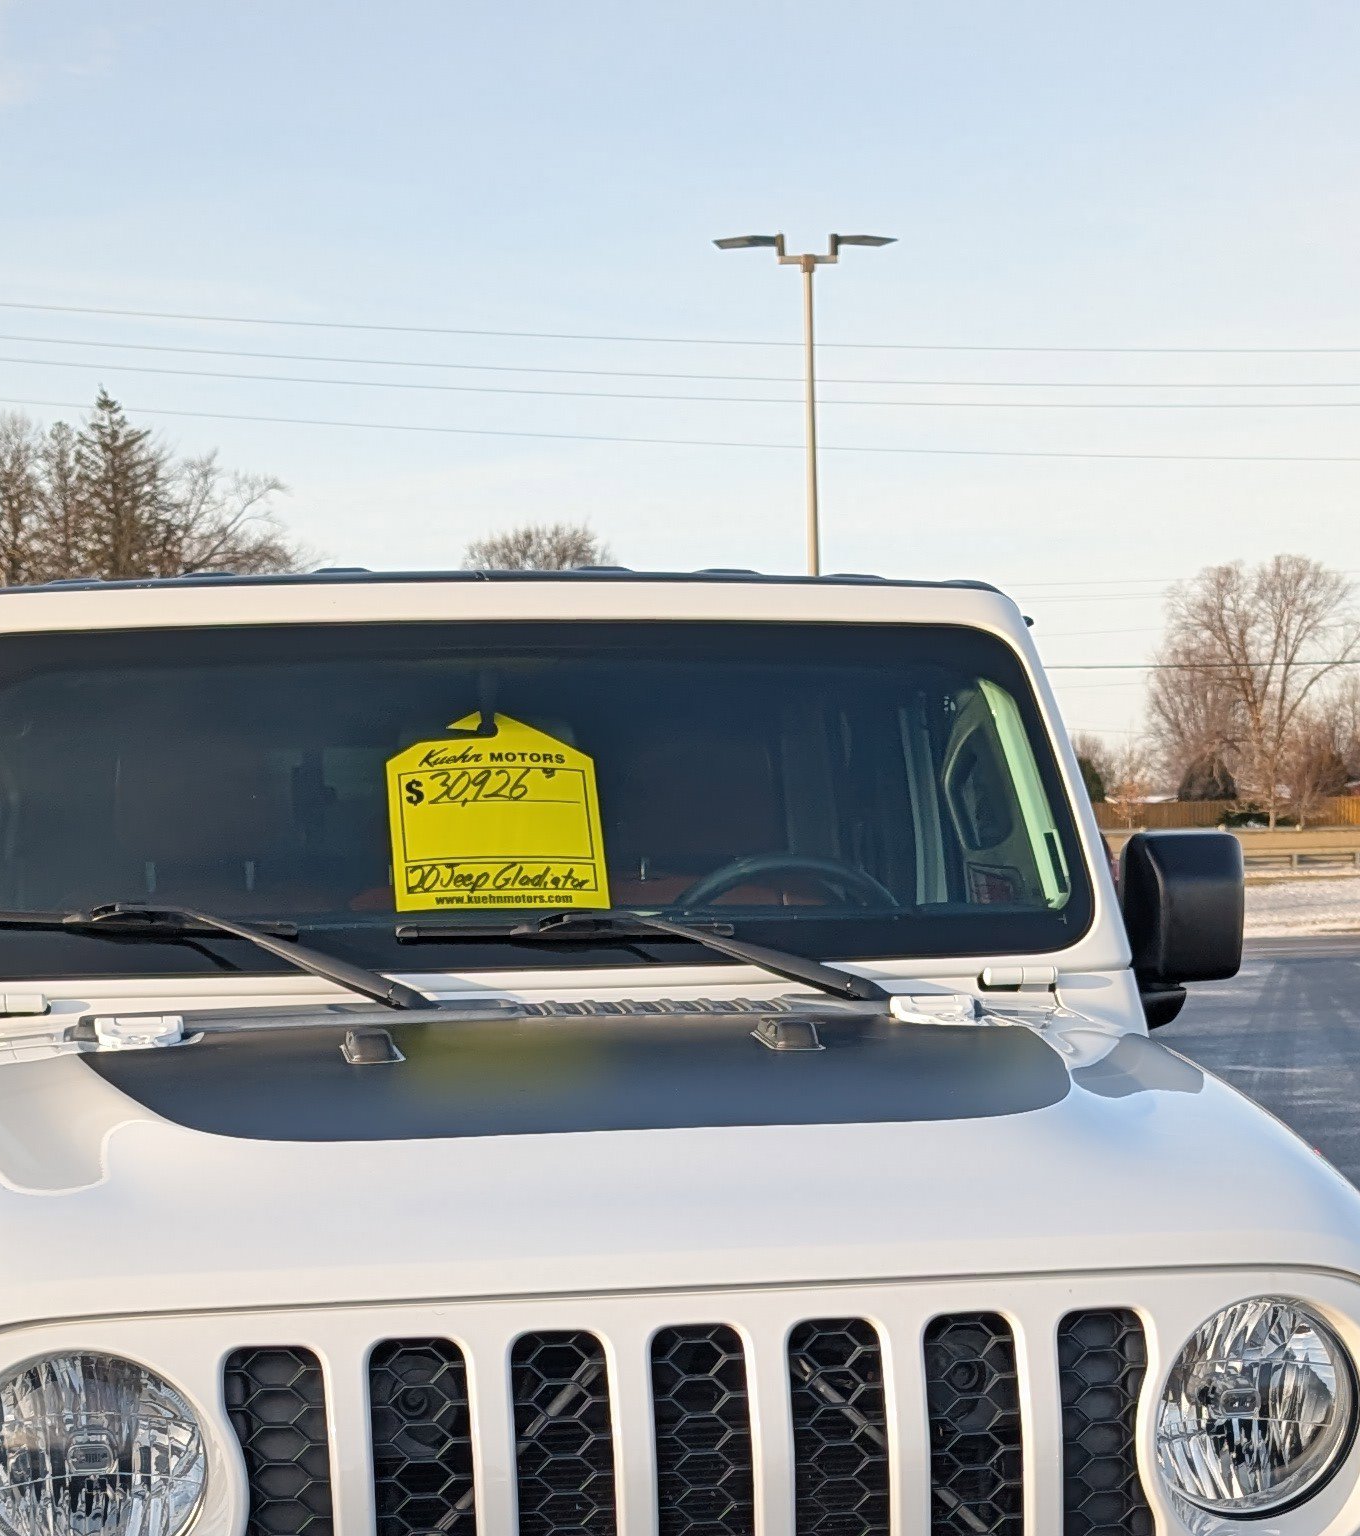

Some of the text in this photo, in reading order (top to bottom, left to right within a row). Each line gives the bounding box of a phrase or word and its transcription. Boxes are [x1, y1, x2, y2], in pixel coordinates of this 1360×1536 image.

[418, 746, 566, 768] Kuehn MOTORS
[435, 893, 574, 905] www.kuehnmotors.com
